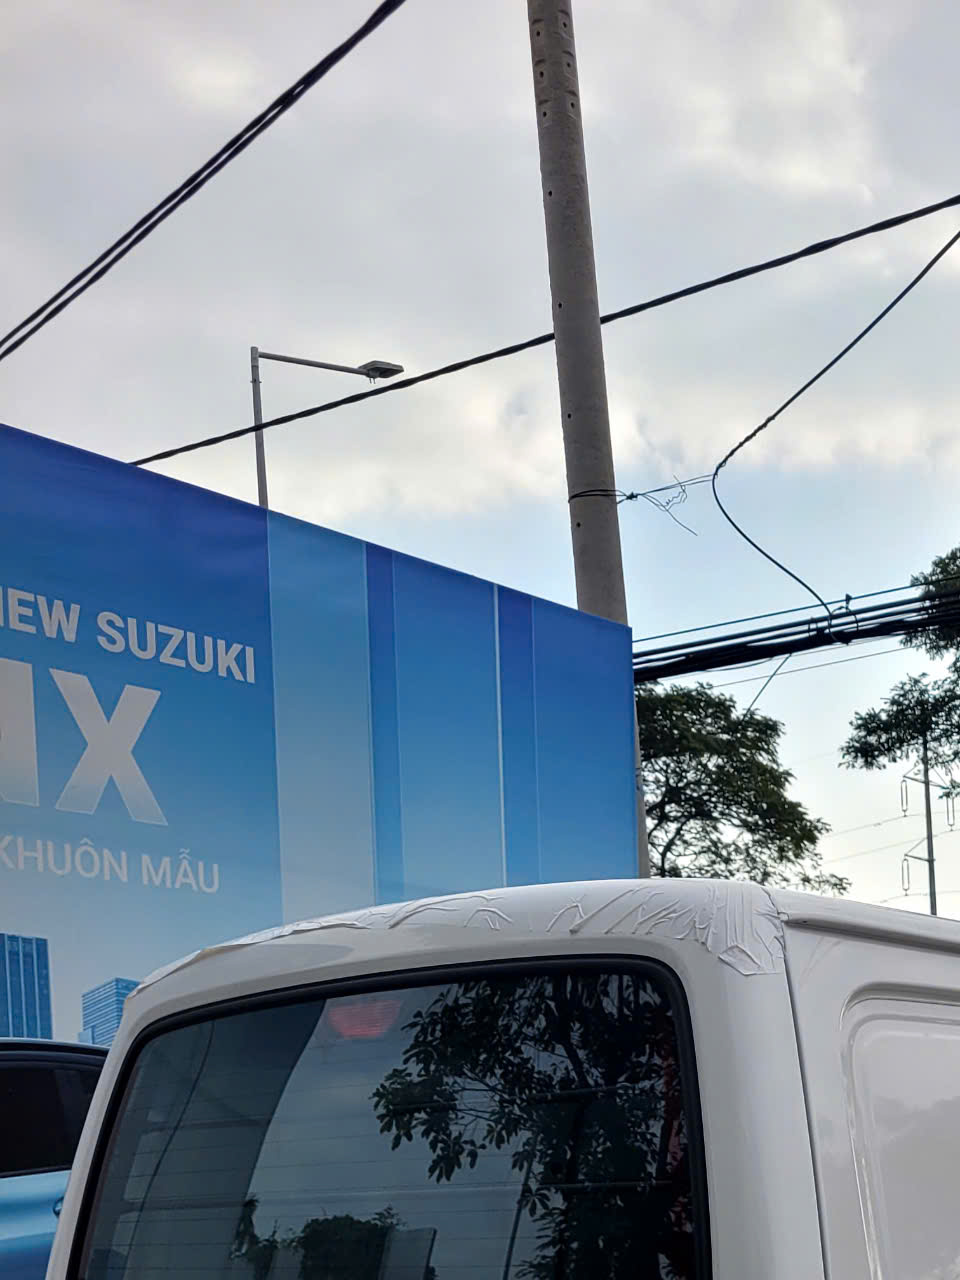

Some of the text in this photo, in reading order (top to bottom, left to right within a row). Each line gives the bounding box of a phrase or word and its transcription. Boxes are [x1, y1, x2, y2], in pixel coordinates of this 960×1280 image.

[0, 586, 255, 684] EW SUZUKI
[141, 848, 219, 894] MẪU
